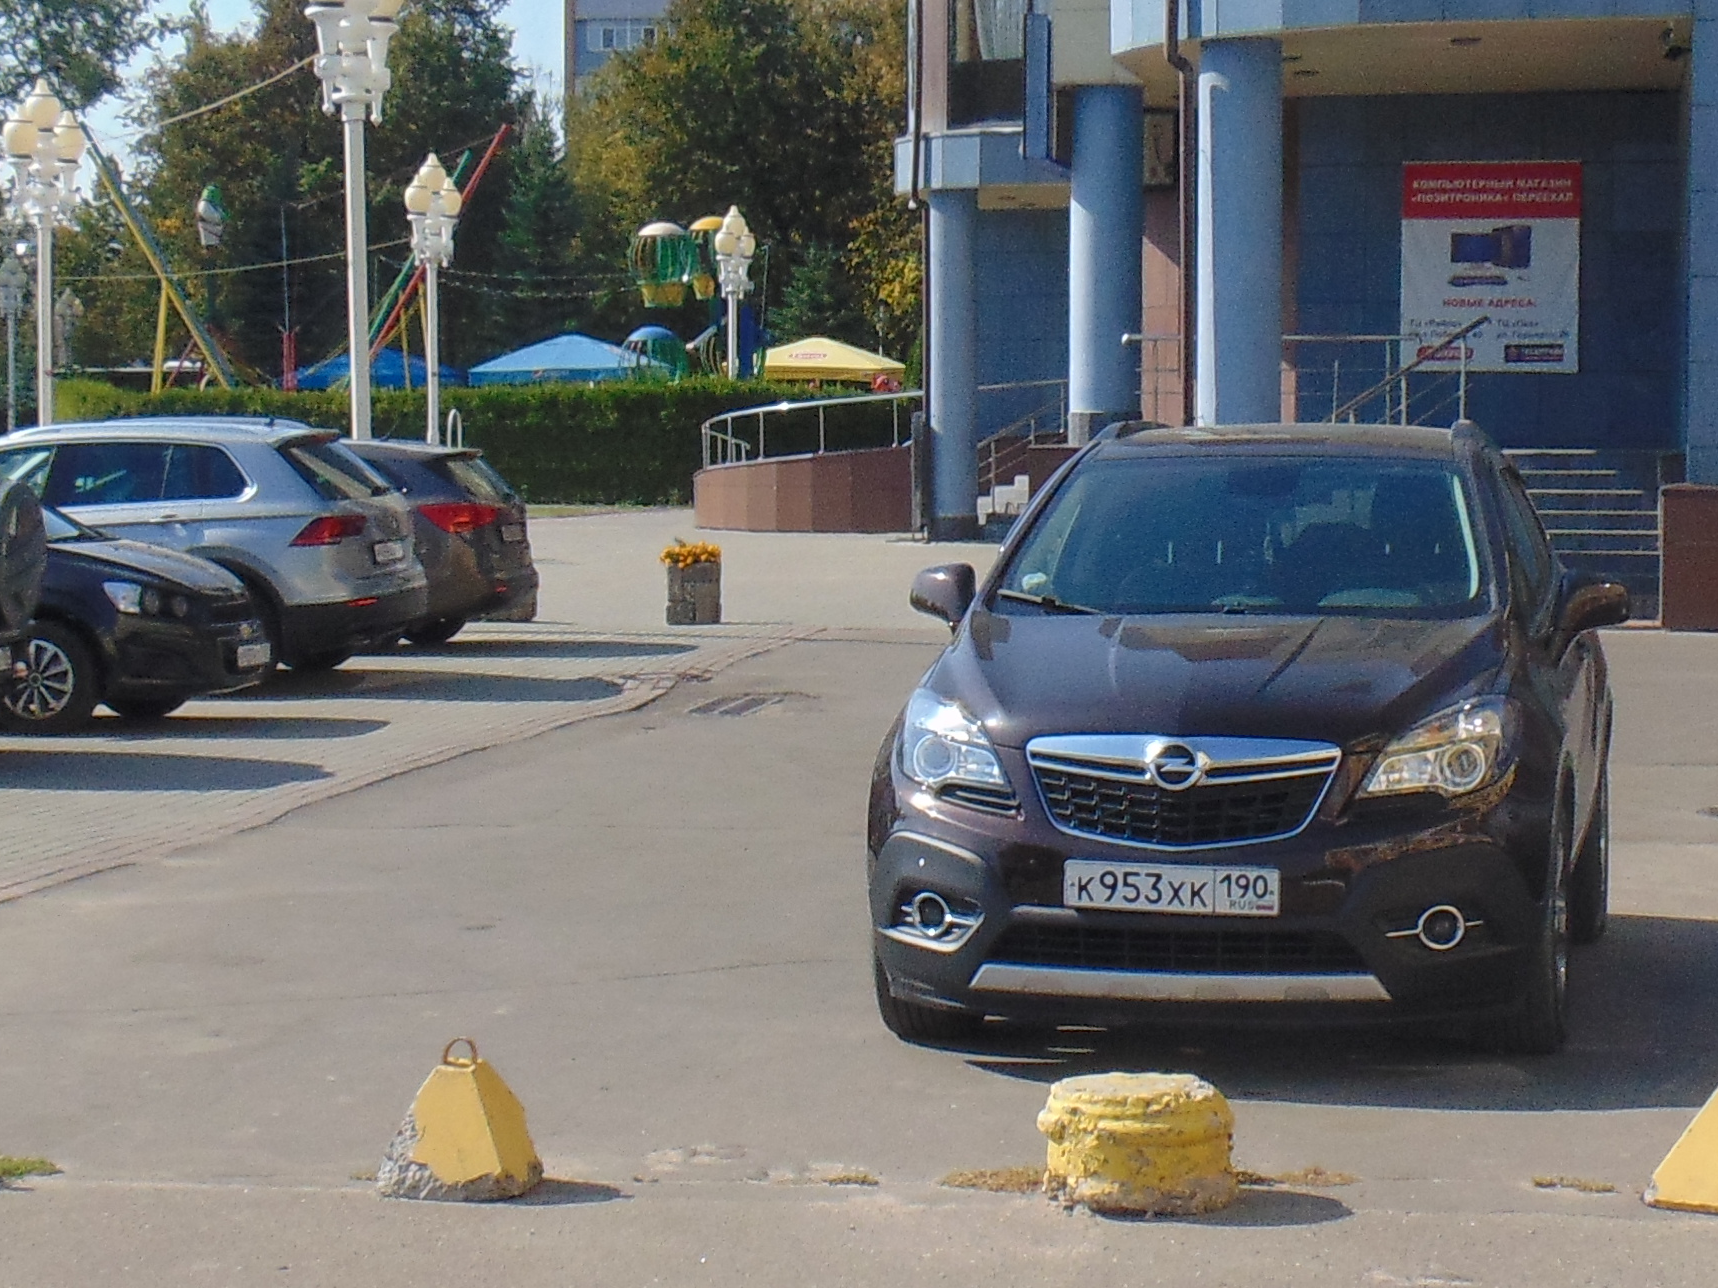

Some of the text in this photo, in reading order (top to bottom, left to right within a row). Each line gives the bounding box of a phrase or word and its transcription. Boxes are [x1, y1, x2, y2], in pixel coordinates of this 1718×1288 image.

[1516, 178, 1572, 188] МАГАЗИН
[1512, 192, 1574, 202] ПЕРЕЕХАЛ
[1442, 298, 1484, 308] НОВЫЕ
[1218, 873, 1268, 899] 190
